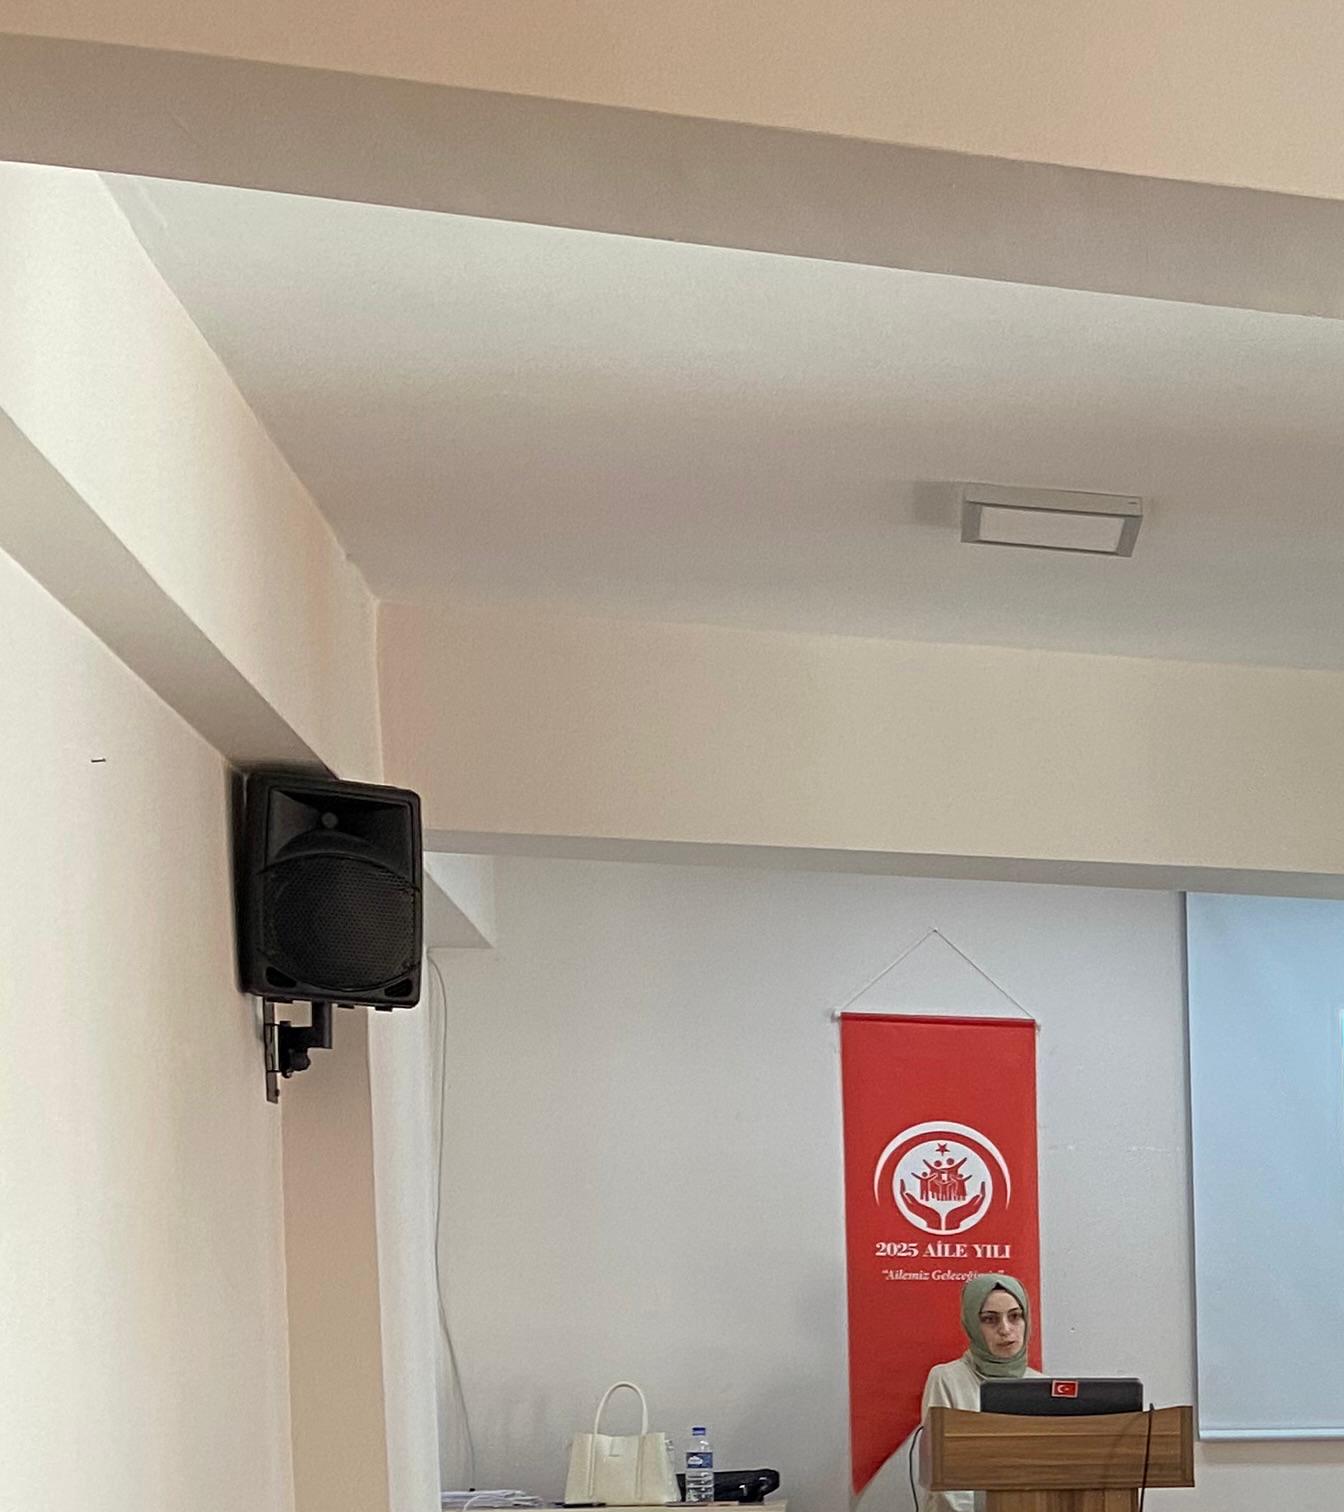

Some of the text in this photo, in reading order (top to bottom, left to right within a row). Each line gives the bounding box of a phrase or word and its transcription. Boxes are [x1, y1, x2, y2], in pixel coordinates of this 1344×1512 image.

[875, 1240, 1011, 1259] 2025 AİLE YILI
